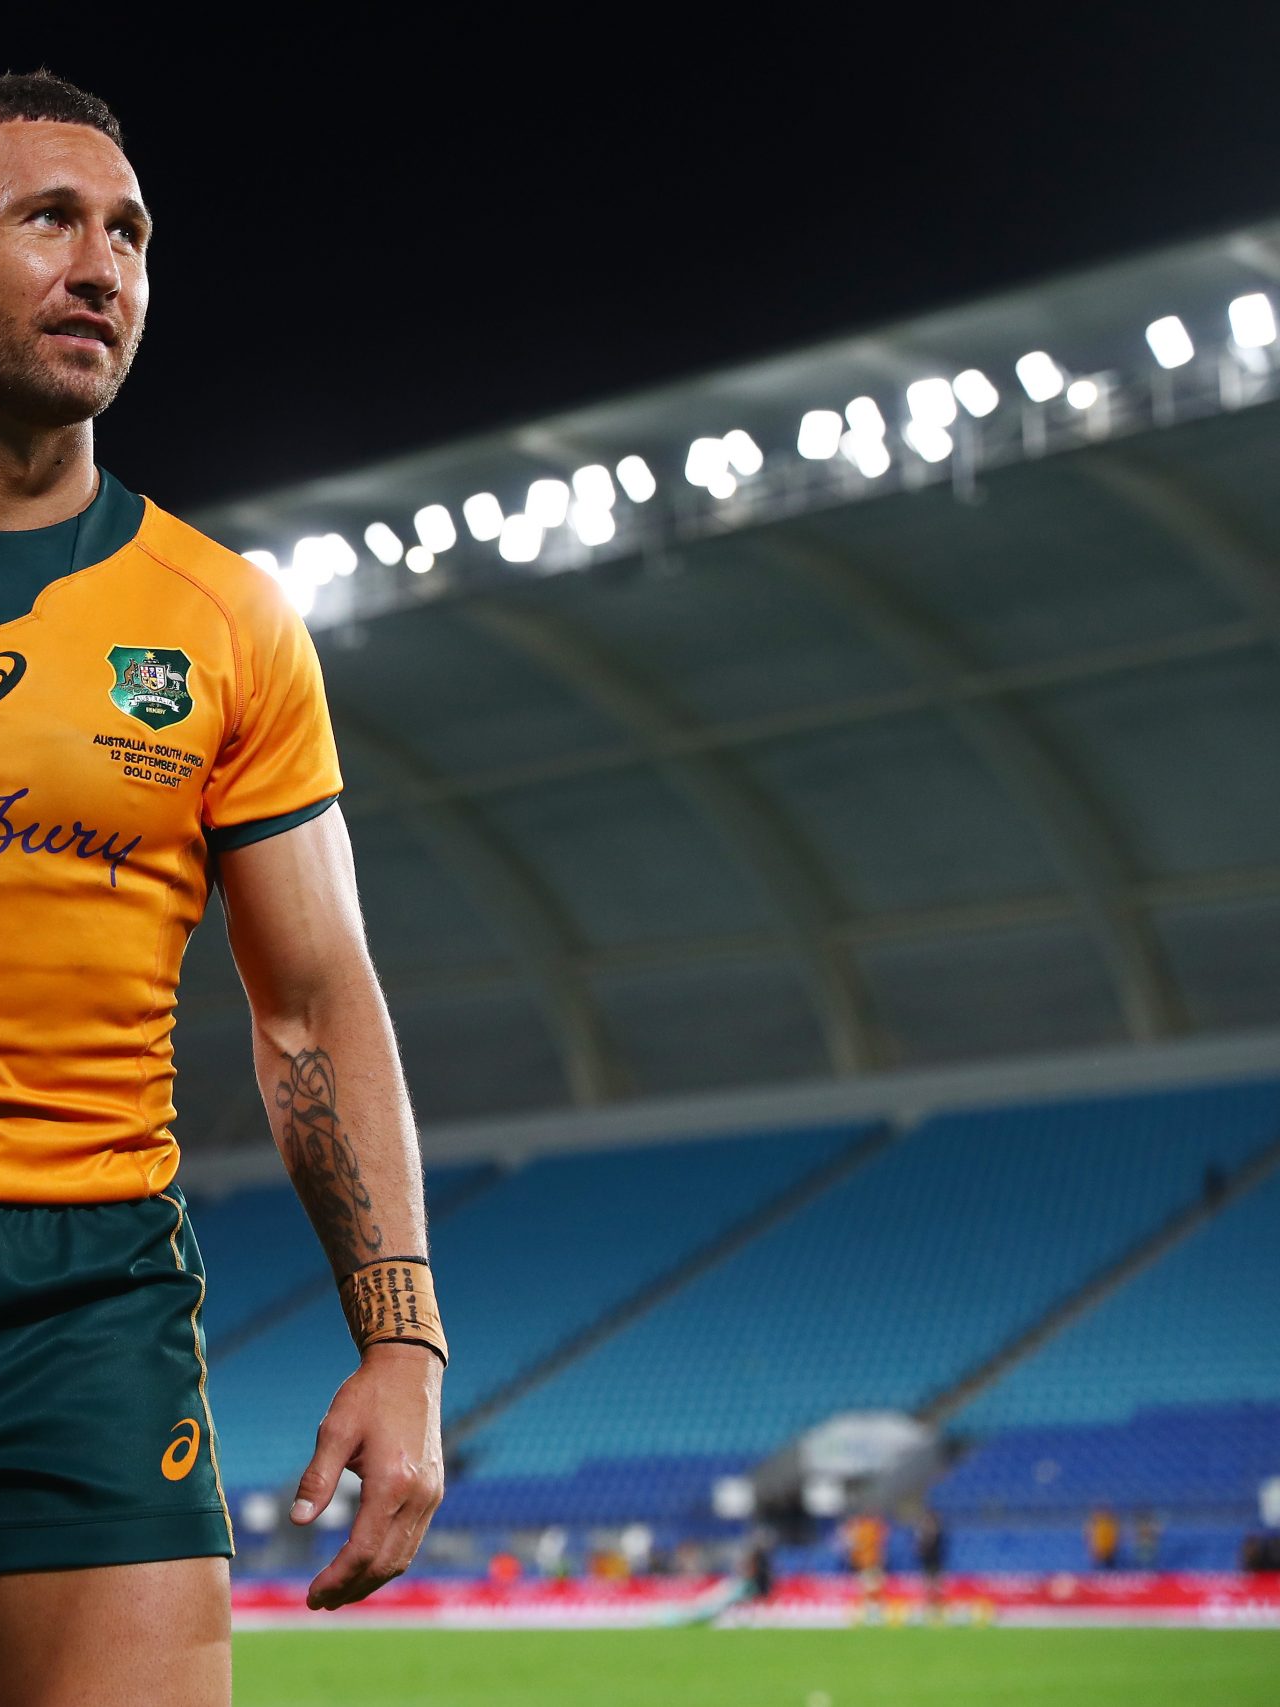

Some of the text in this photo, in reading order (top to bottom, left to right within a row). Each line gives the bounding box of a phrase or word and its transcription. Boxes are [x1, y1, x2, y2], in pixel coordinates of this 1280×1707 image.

[93, 734, 146, 752] AUSTRALIA
[155, 745, 181, 759] SOUTH
[183, 753, 204, 768] AFRICA
[110, 750, 192, 778] 12 SEPTEMBER 2021
[124, 766, 181, 788] GOLD COAST
